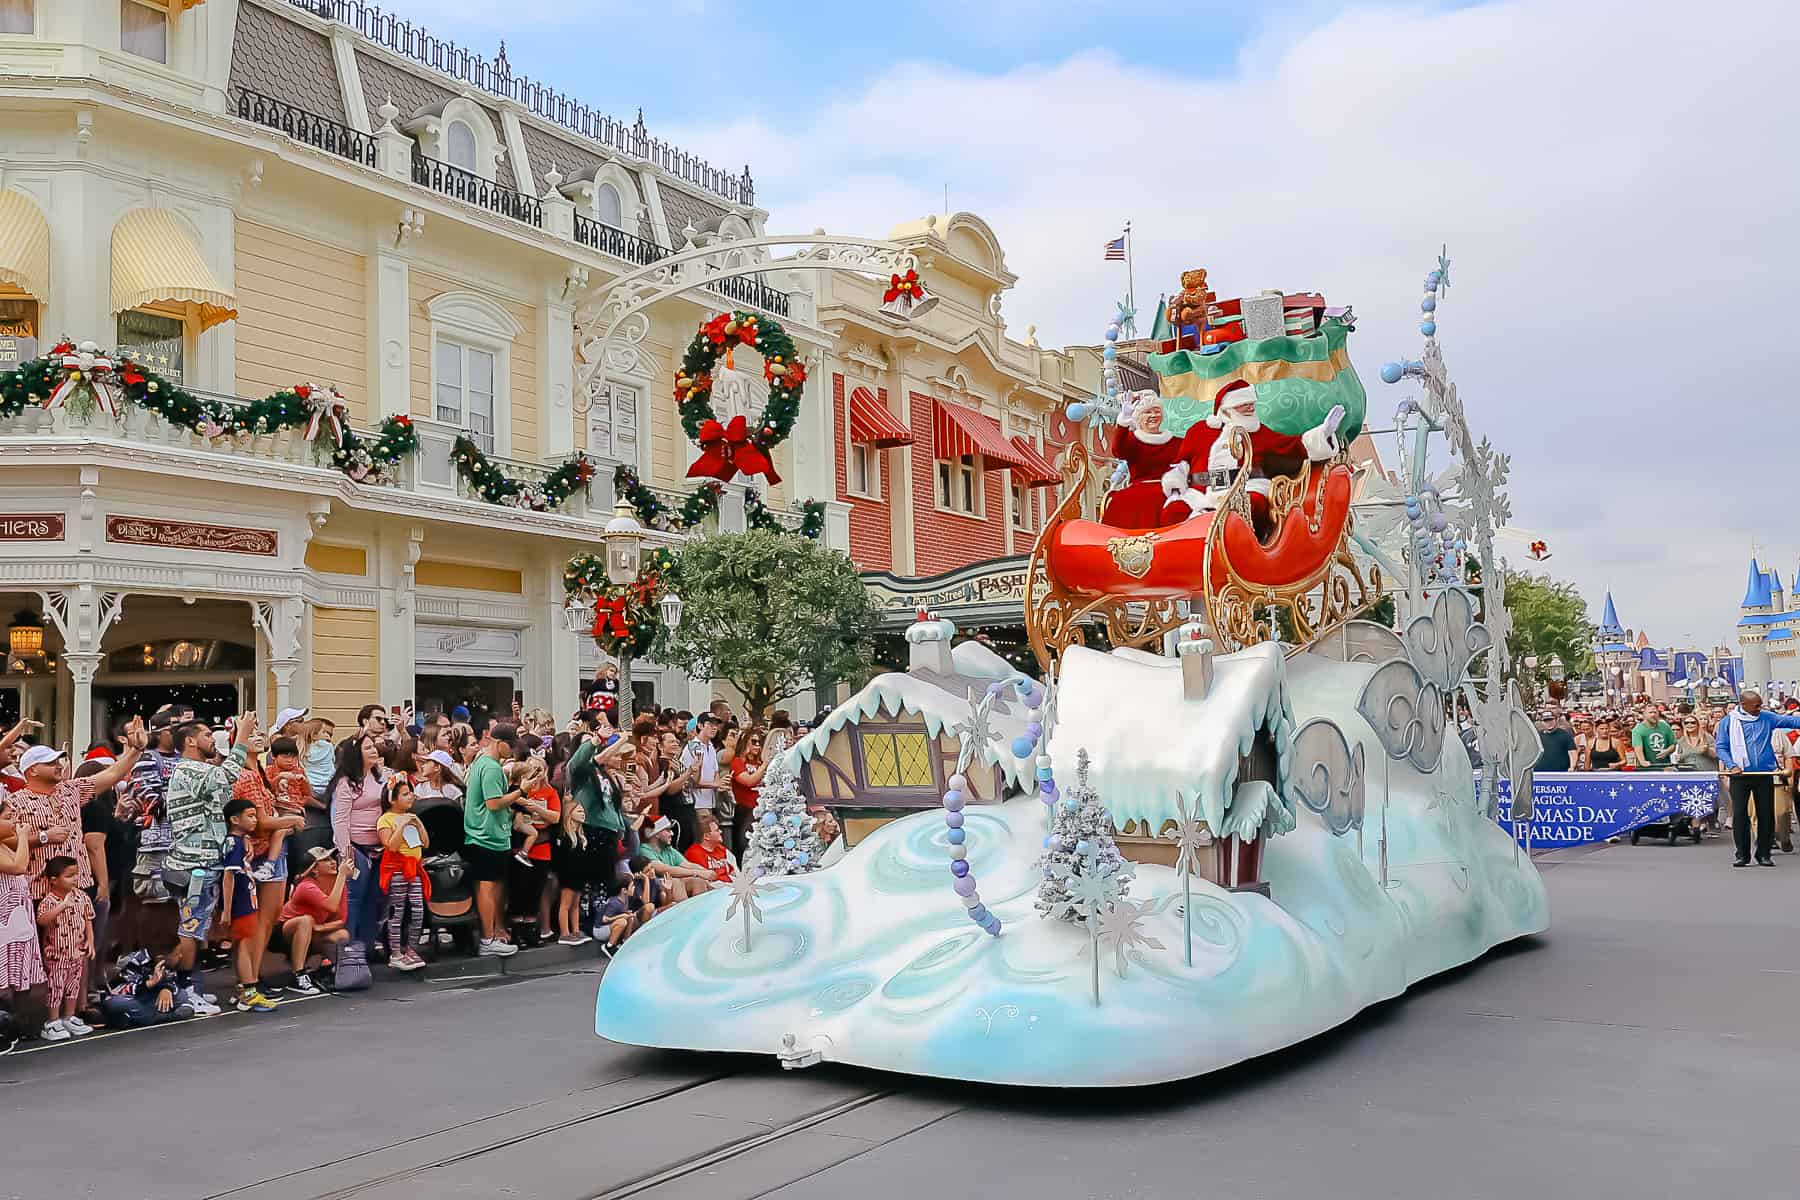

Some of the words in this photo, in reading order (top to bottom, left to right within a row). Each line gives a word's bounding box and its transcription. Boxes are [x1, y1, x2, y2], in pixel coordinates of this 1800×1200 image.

[118, 523, 158, 539] DISNEY
[937, 587, 966, 603] Street
[1532, 795, 1577, 805] AGICAL
[1577, 806, 1618, 824] DAY
[1518, 823, 1595, 841] PARADE
